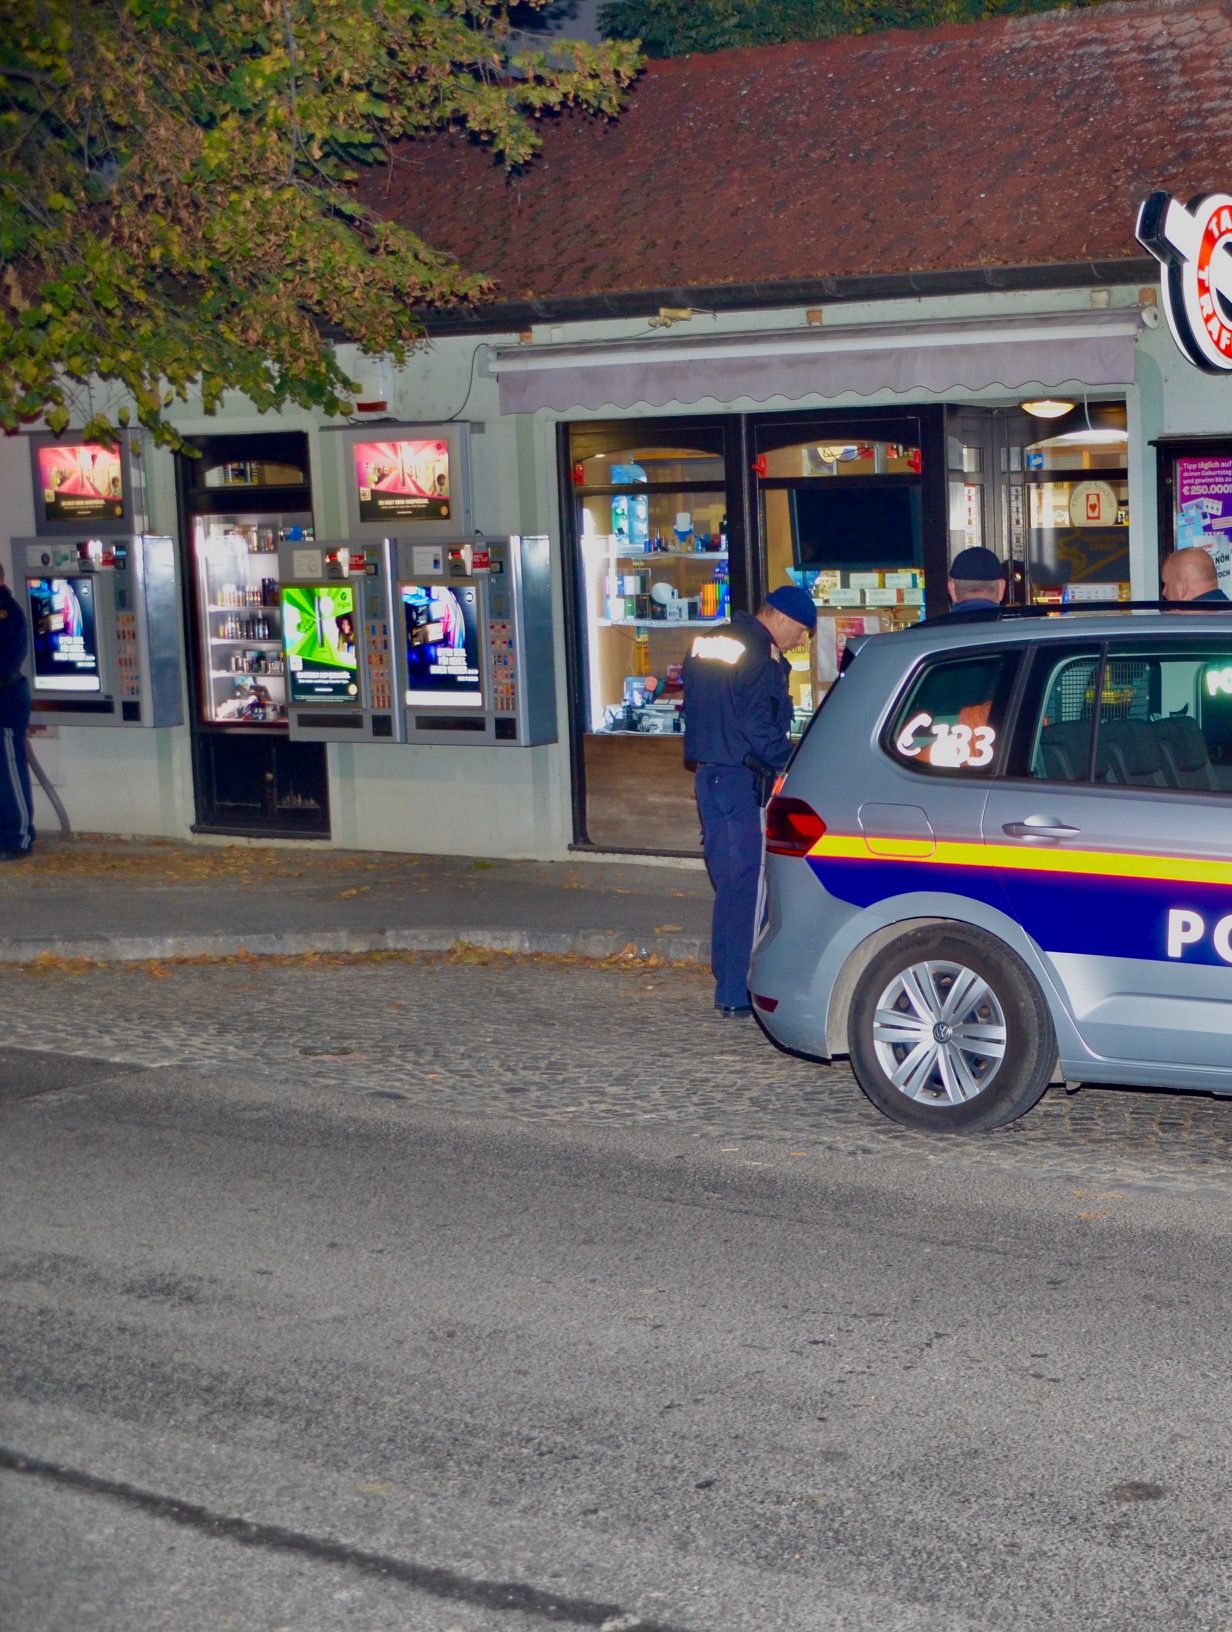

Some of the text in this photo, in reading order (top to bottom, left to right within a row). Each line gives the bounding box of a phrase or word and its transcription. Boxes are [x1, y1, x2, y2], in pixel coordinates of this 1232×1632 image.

[1183, 460, 1232, 470] Tipp täglich auf
[1182, 484, 1232, 496] € 250.000!
